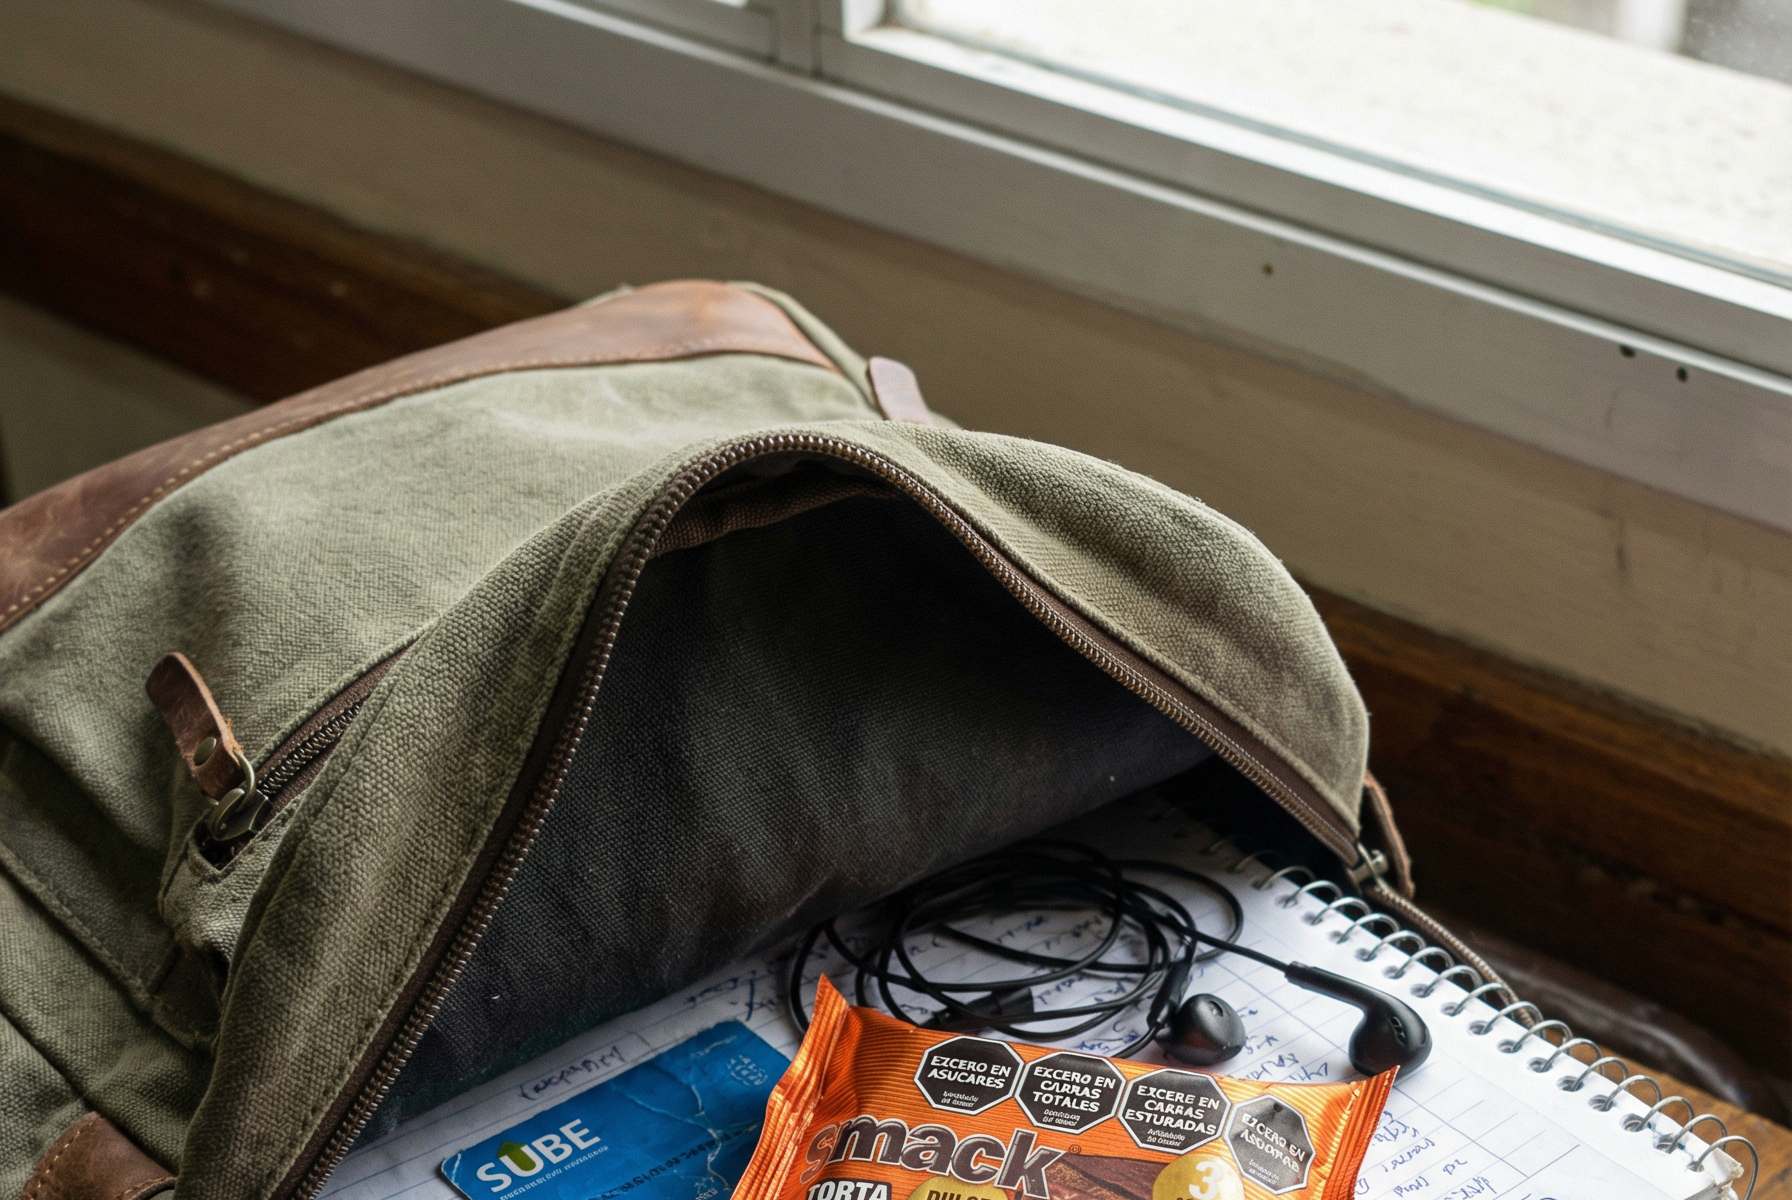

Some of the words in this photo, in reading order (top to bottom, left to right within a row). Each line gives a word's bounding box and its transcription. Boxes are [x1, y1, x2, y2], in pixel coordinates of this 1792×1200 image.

[927, 1069, 1006, 1089] ASUCARES
[990, 1064, 1012, 1078] EN
[1094, 1076, 1116, 1089] EN
[1032, 1091, 1101, 1113] TOTALES
[1198, 1097, 1220, 1111] EN
[1125, 1108, 1217, 1136] ESTURADAS
[476, 1118, 601, 1193] SUBE
[1188, 1160, 1222, 1200] 3
